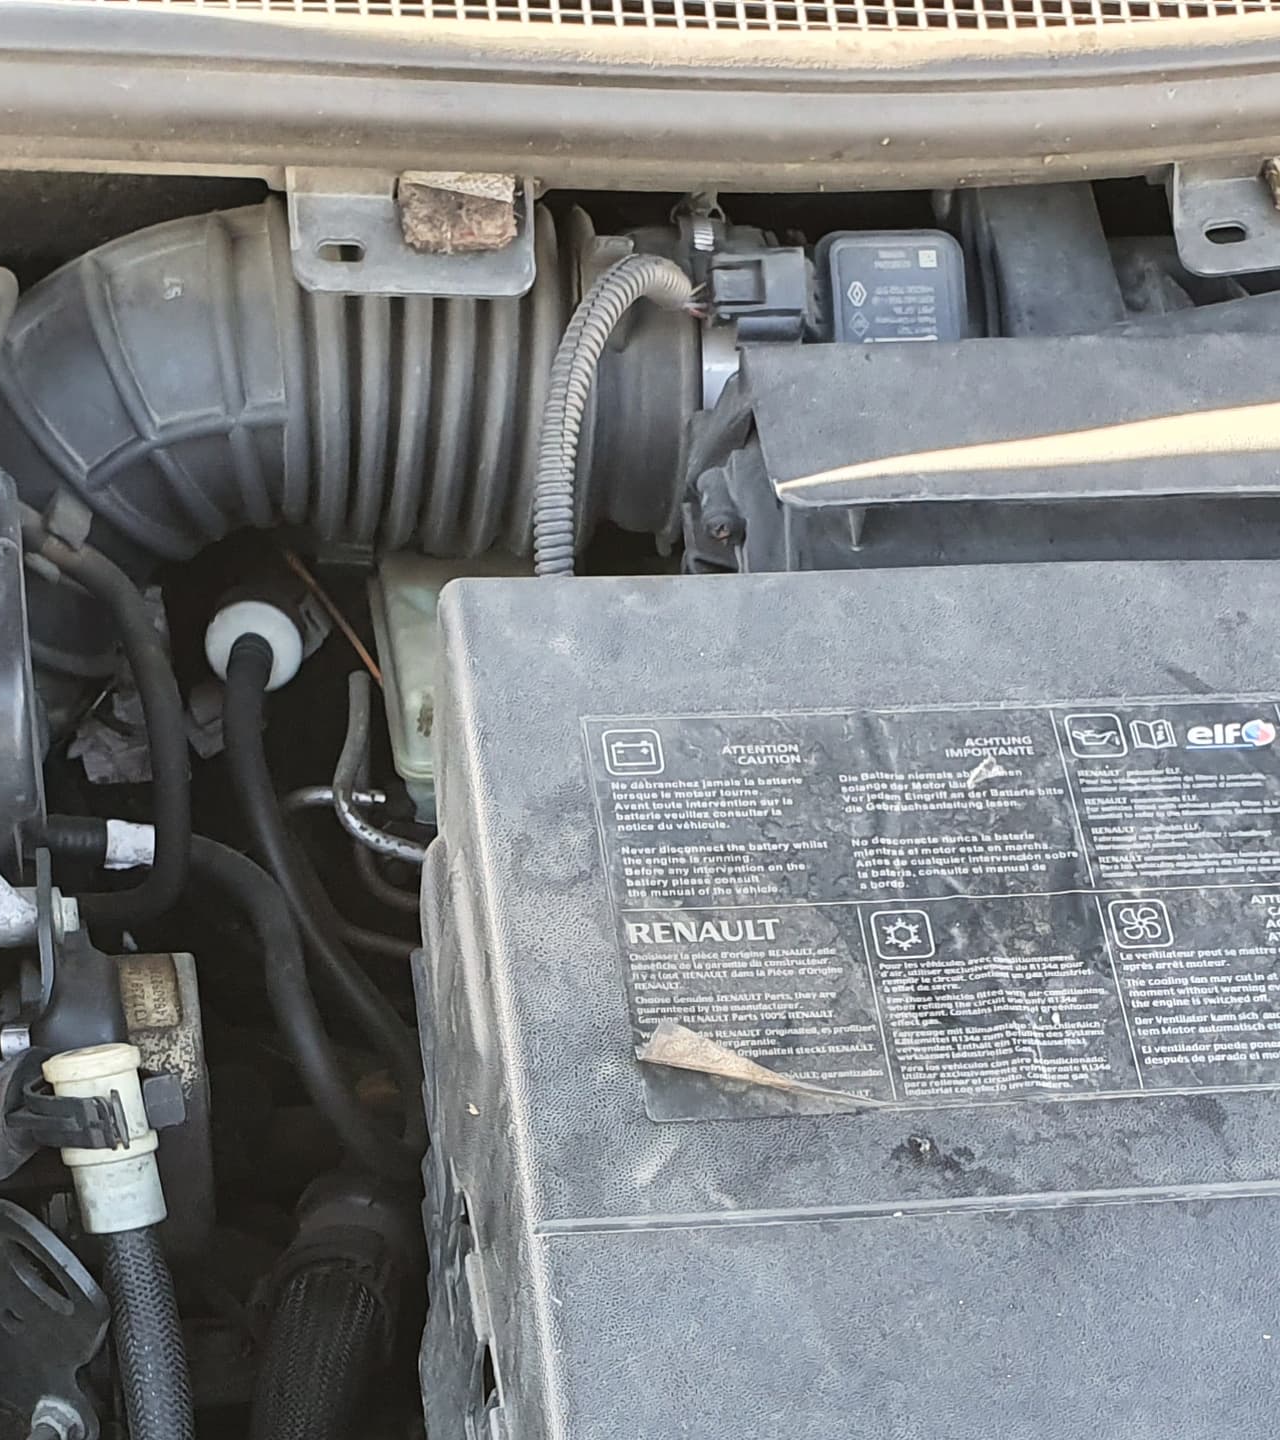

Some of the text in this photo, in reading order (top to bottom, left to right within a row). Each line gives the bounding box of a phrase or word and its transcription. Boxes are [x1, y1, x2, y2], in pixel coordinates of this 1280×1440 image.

[1186, 724, 1244, 744] elf
[964, 736, 1032, 746] ACHTUNG
[721, 744, 799, 754] ATTENTION
[945, 746, 1035, 757] IMPORTANTE
[738, 754, 801, 764] CAUTION
[626, 917, 783, 945] RENAULT
